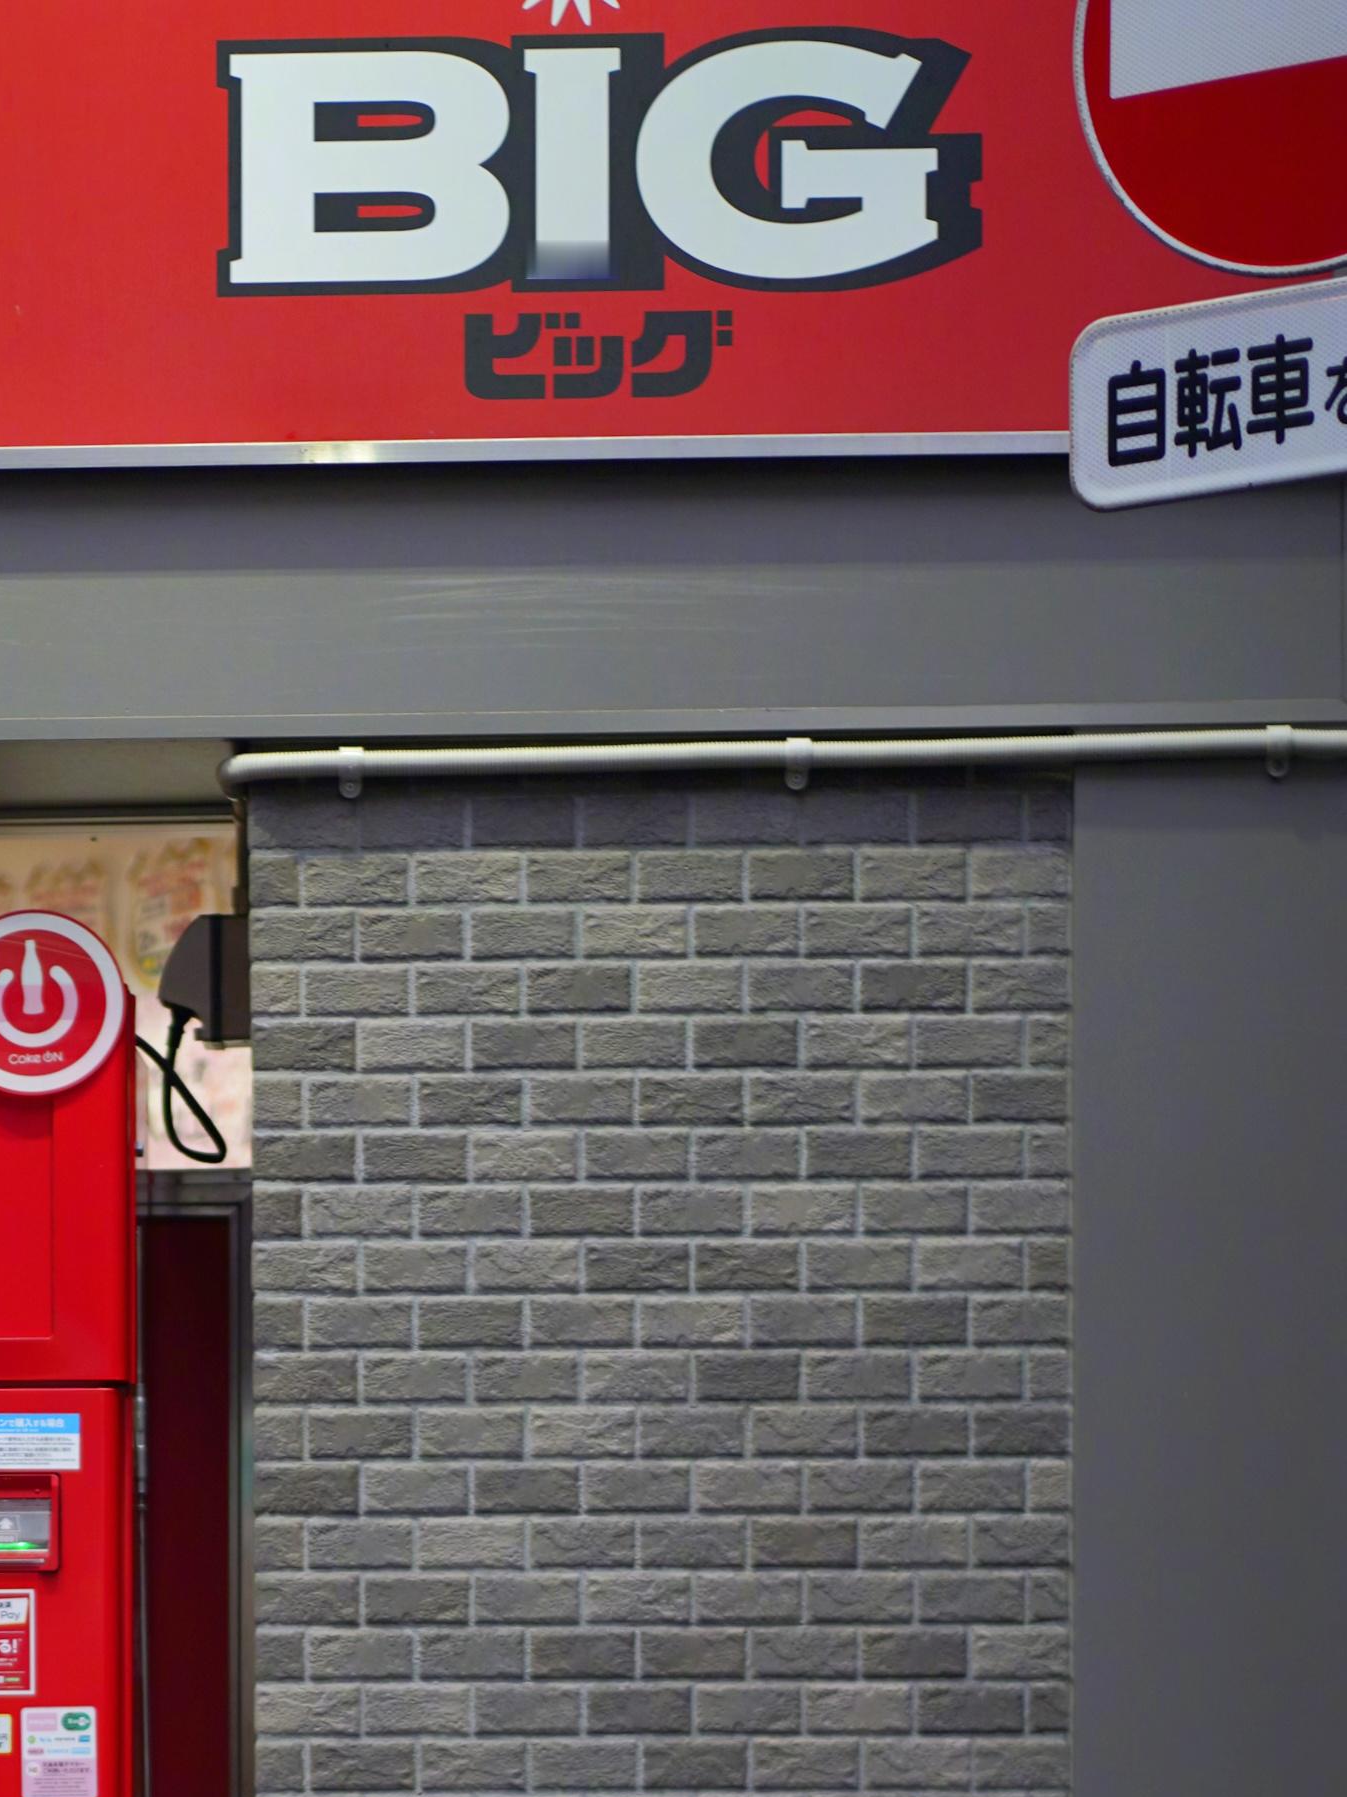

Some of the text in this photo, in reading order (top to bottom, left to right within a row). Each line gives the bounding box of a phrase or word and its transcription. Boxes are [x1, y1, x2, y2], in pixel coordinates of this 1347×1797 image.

[222, 32, 970, 292] BIG
[464, 309, 734, 400] ビッグ
[8, 1053, 42, 1065] Coke
